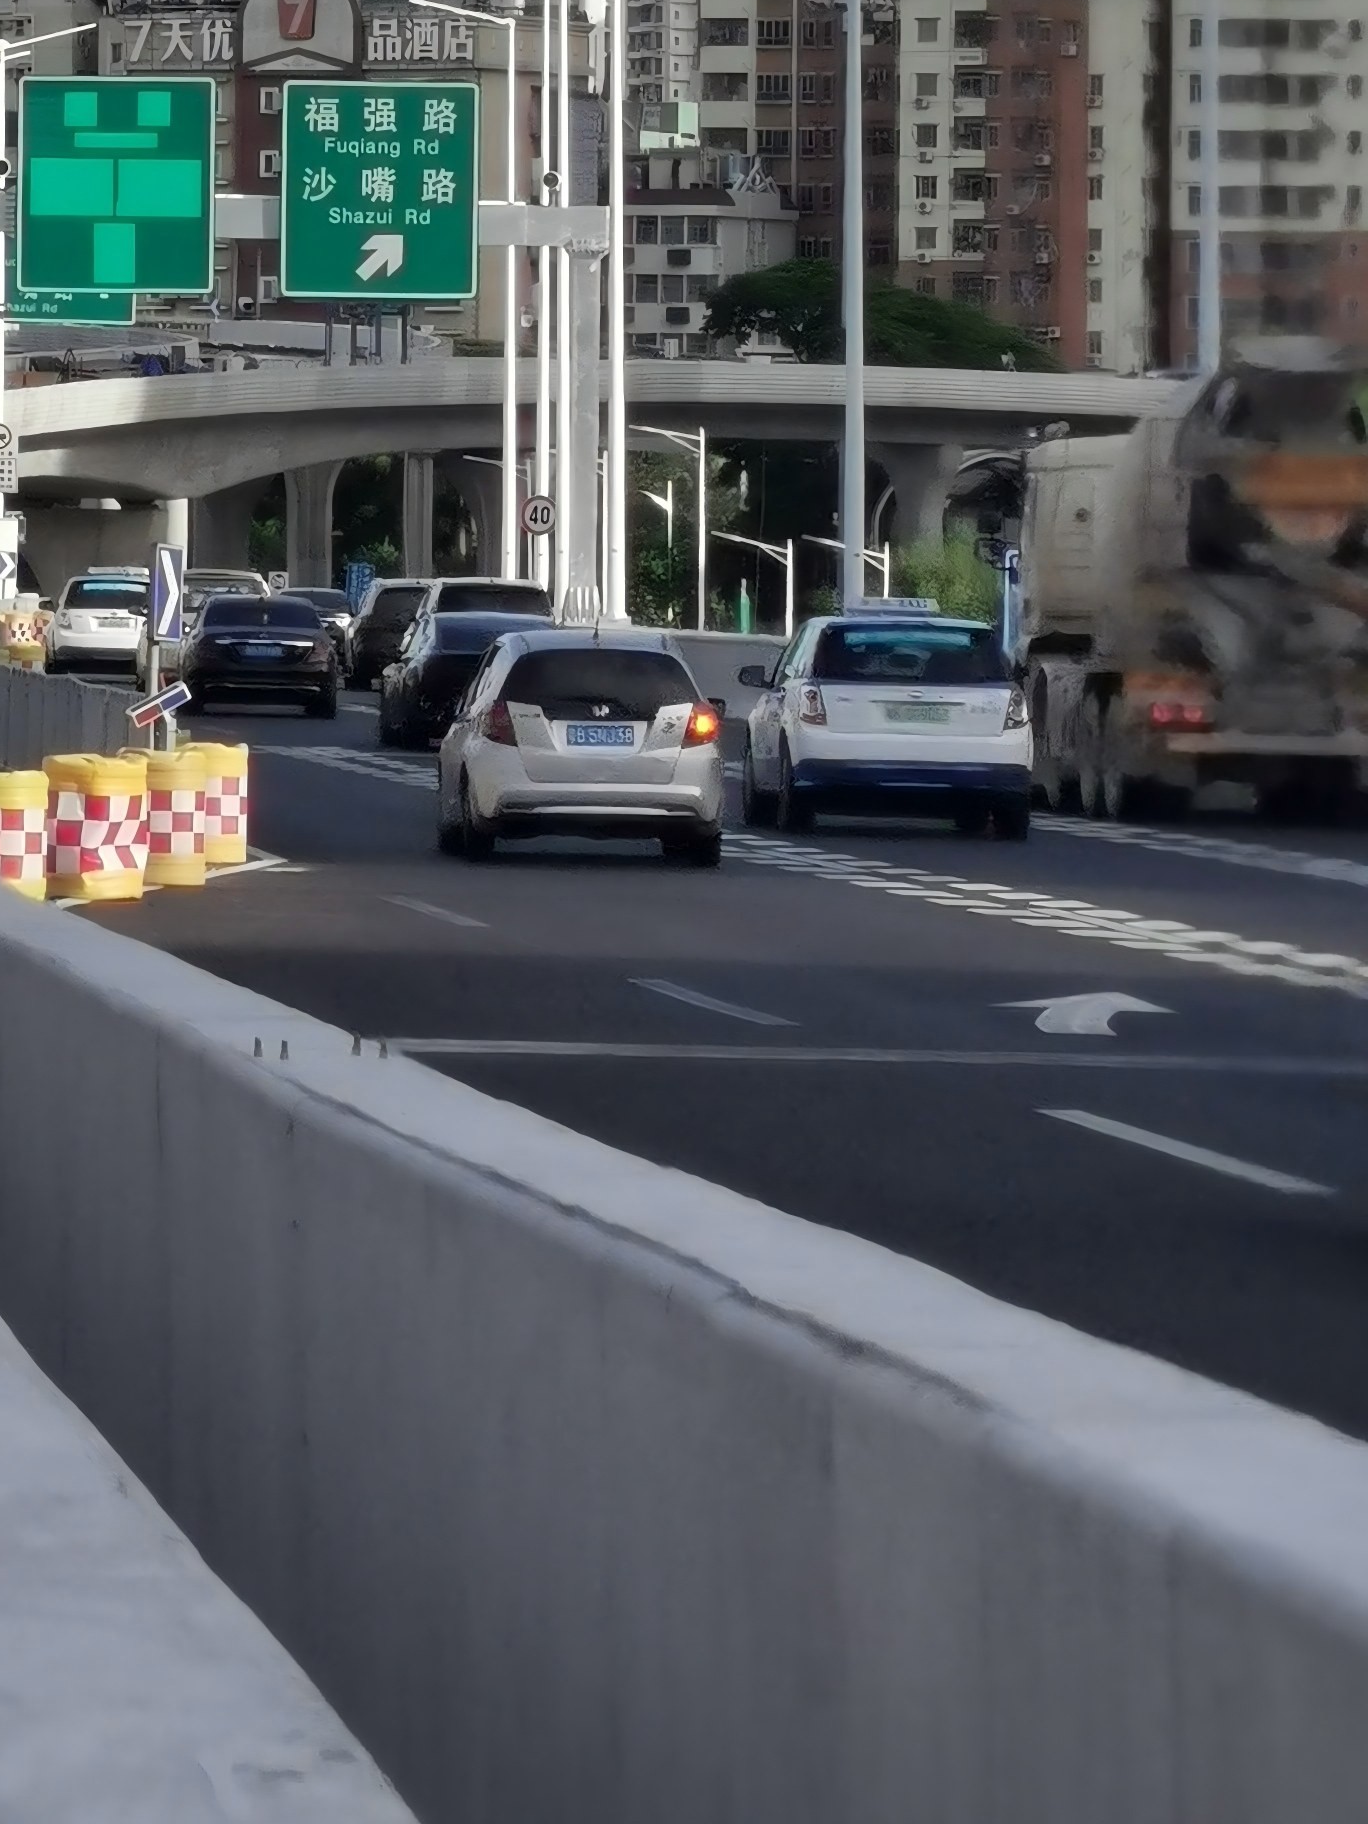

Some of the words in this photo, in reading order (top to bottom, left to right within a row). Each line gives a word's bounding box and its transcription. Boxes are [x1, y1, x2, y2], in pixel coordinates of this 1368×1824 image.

[367, 18, 478, 62] 品酒店
[304, 97, 458, 135] 福强路
[324, 137, 401, 158] Fuqiang
[413, 138, 439, 155] Rd
[302, 166, 457, 204] 沙嘴路
[328, 207, 393, 224] Shazui
[405, 208, 431, 225] Rd
[529, 505, 551, 525] 40
